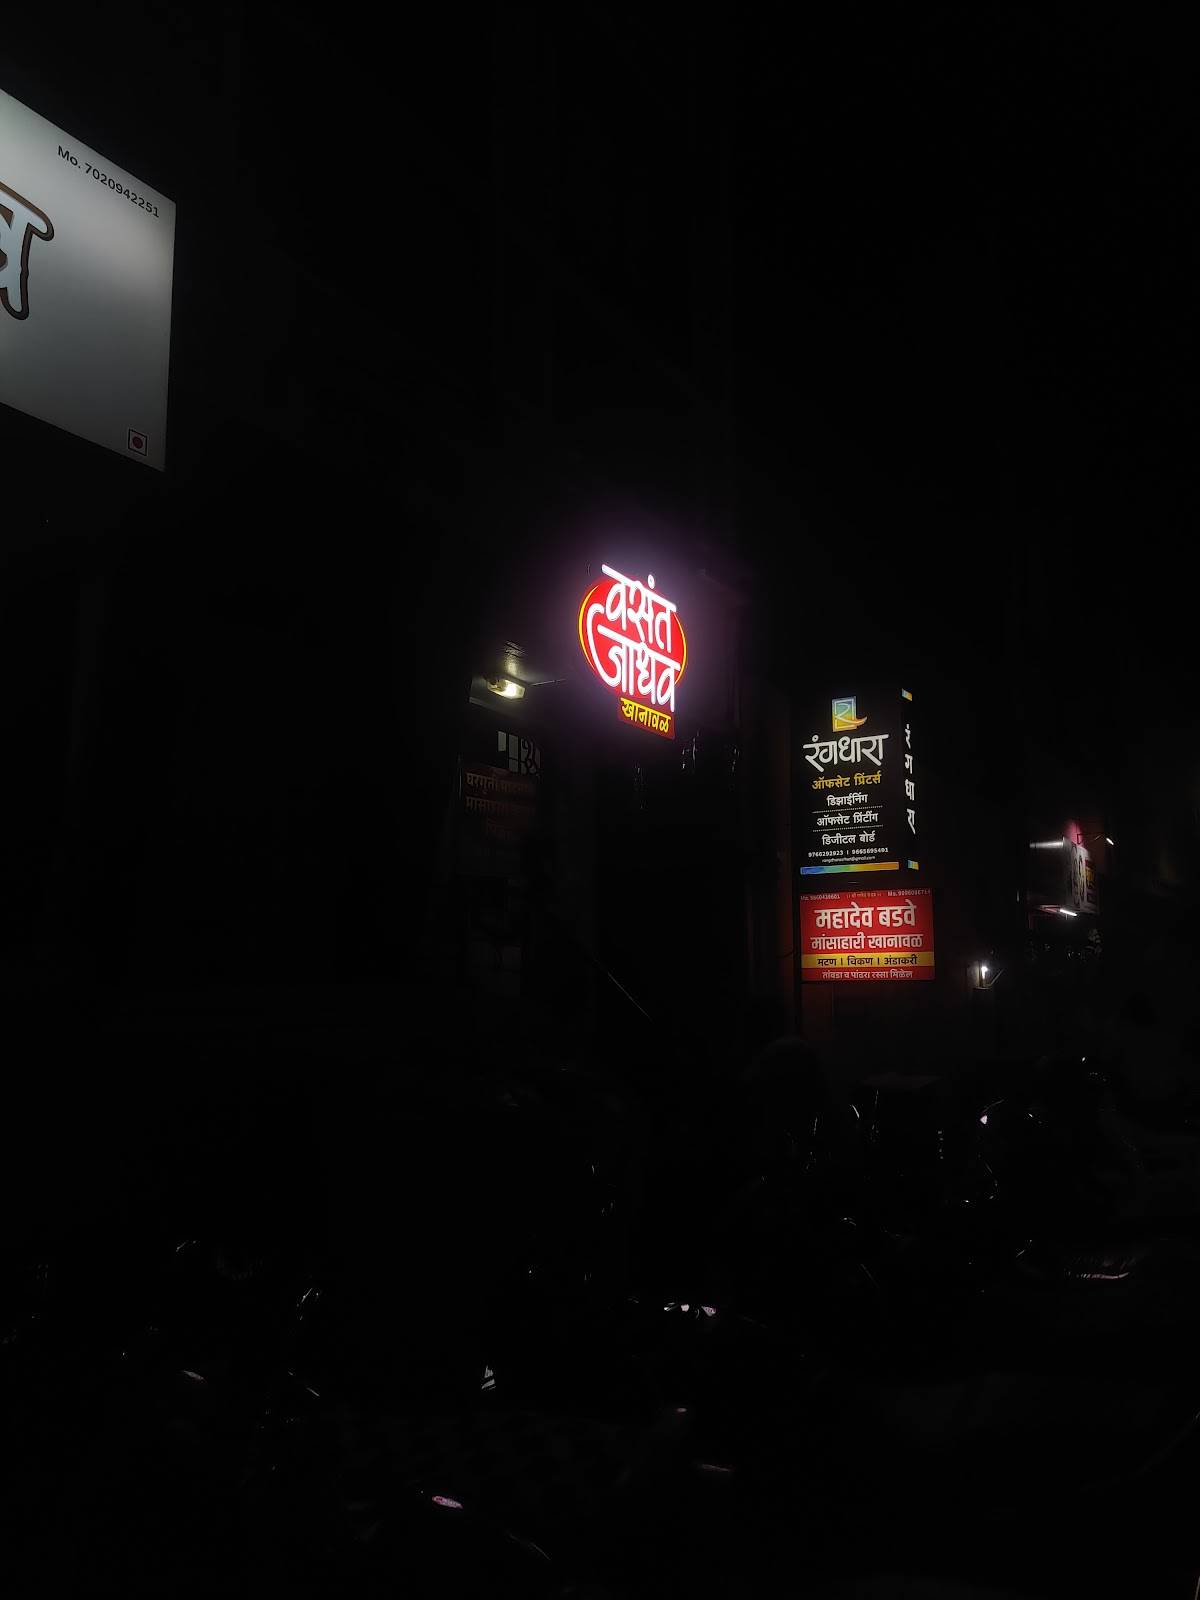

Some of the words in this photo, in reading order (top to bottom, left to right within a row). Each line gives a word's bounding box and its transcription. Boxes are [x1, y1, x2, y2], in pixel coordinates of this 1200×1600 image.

[57, 145, 82, 169] Mo.
[84, 162, 161, 218] 7020942251
[601, 564, 677, 654] वसंत
[586, 603, 681, 712] जाधव
[620, 697, 672, 733] खानावळ
[802, 734, 889, 773] रंगधारा
[811, 776, 851, 790] ऑफसेट
[854, 770, 883, 786] प्रिंटर्स
[826, 792, 869, 807] डिझाईनिंग
[816, 812, 851, 827] ऑफसेट
[821, 832, 856, 846] डिजीटल
[859, 830, 876, 843] बोर्ड
[814, 902, 875, 930] महादेव
[877, 899, 918, 928] बडवे
[810, 931, 866, 950] मांसाहारी
[867, 933, 924, 949] खानावळ
[817, 957, 837, 967] मटण
[884, 954, 918, 965] अंडाकरी
